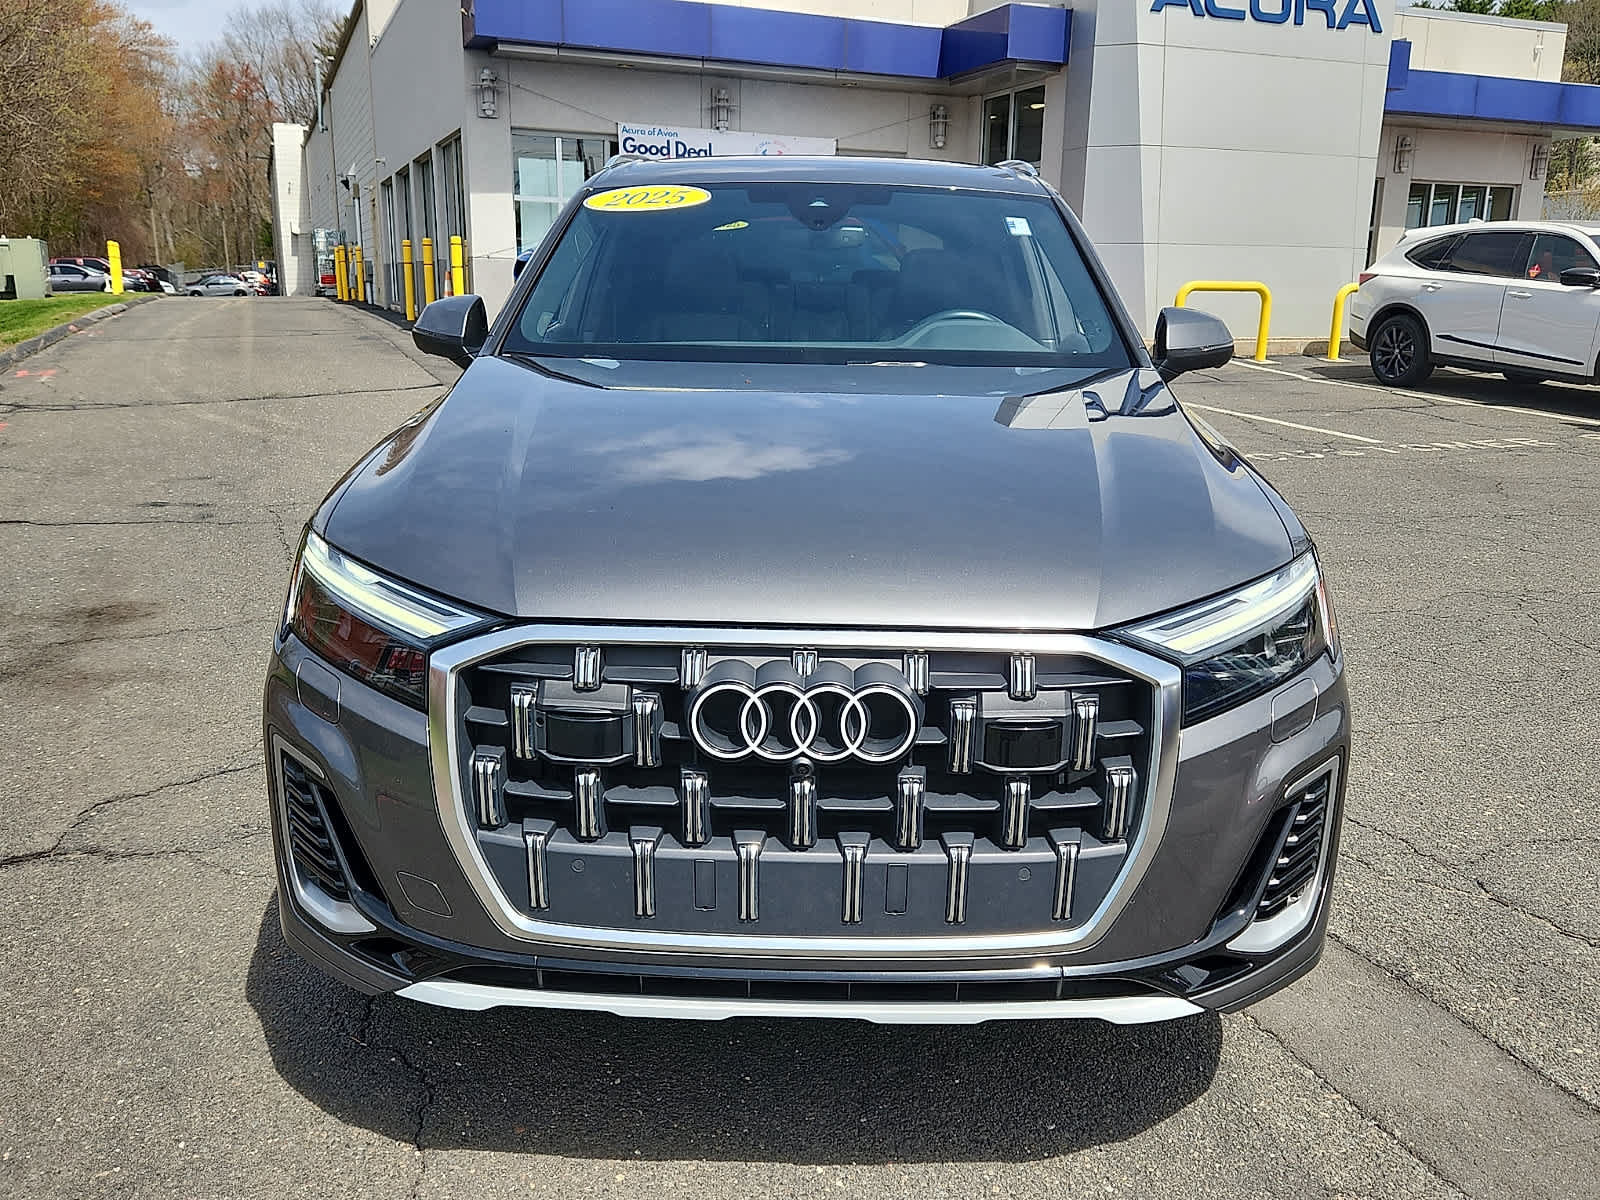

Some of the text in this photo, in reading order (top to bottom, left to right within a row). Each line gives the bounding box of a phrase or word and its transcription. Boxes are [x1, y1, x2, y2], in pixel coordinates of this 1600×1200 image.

[621, 126, 679, 138] Acura of Avon
[622, 136, 713, 158] Good Deal
[605, 190, 690, 207] 2025
